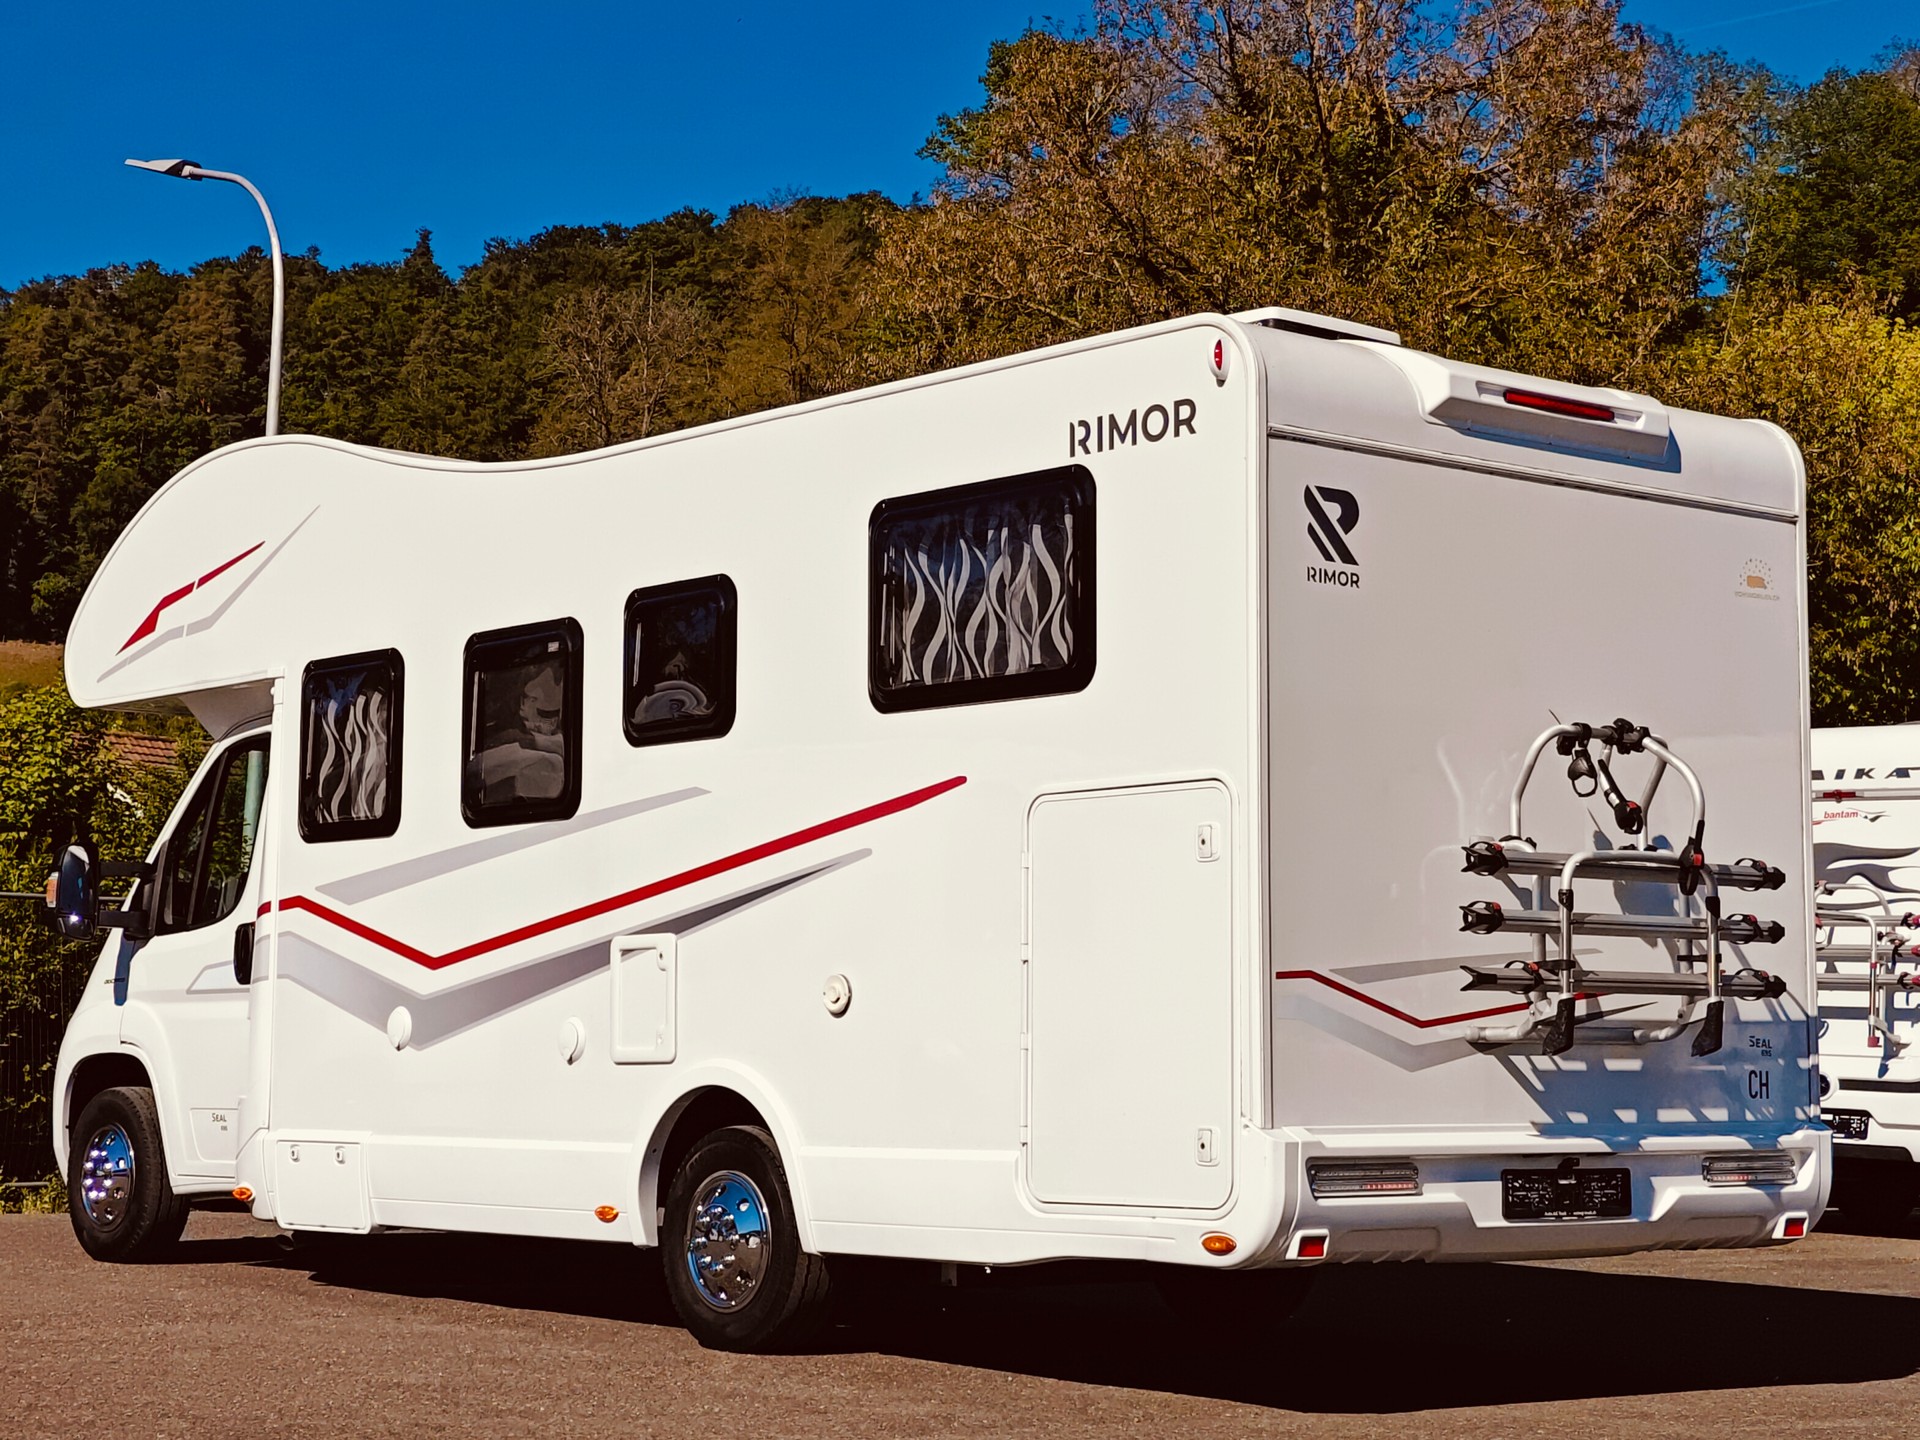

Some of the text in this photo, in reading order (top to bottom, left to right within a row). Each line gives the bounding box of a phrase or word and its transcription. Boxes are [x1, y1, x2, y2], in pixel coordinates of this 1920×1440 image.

[1069, 398, 1197, 458] RIMOR
[1307, 566, 1360, 589] RIMOR
[1823, 811, 1859, 819] bantam
[1748, 1069, 1770, 1099] CH
